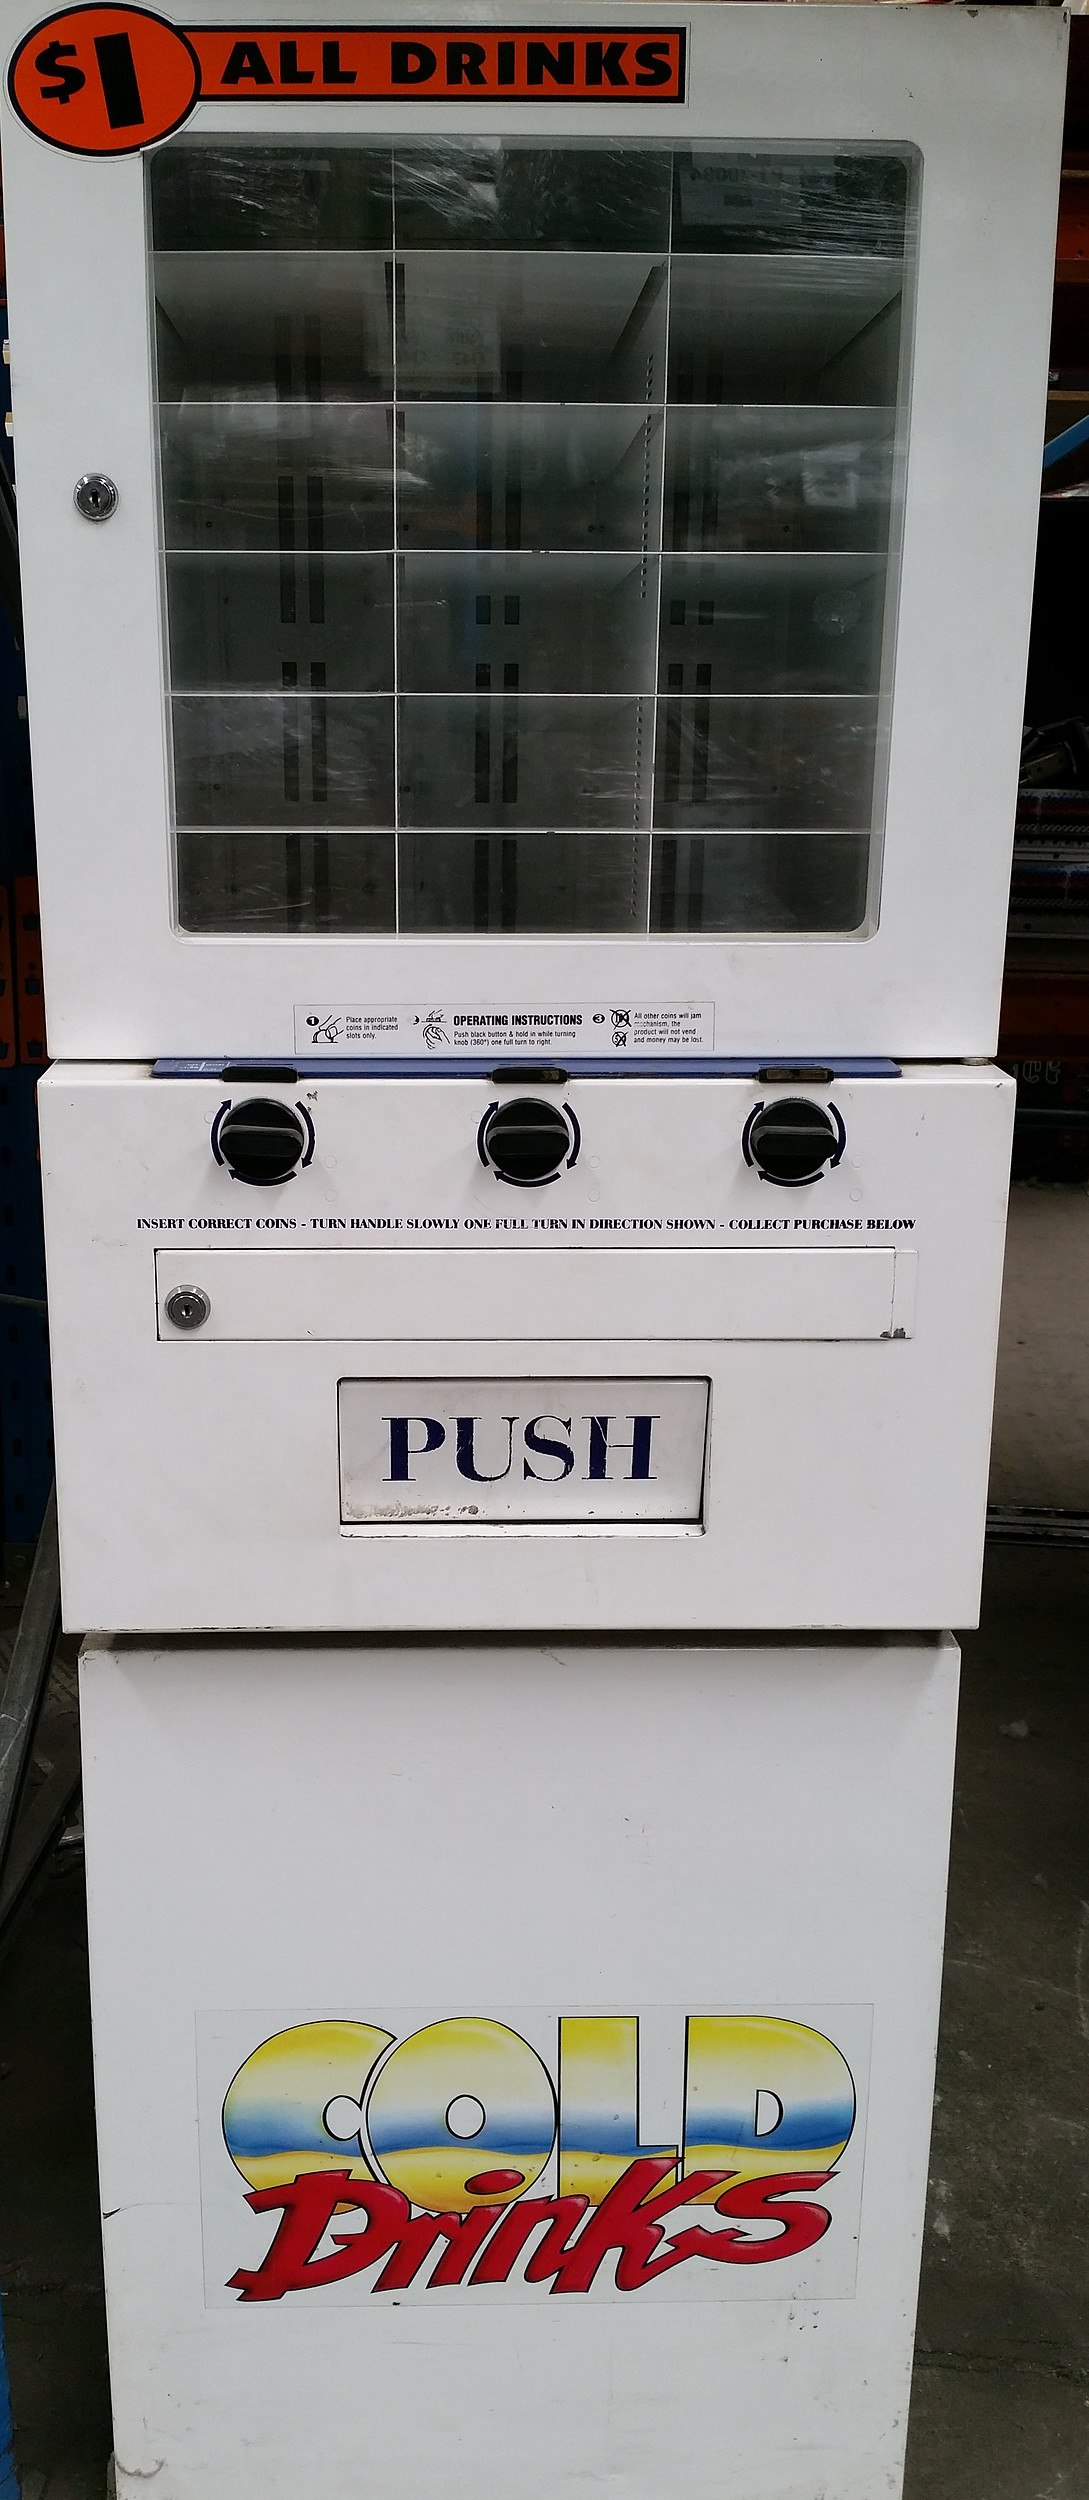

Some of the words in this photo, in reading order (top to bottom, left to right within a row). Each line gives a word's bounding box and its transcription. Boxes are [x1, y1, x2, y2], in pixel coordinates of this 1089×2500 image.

[220, 41, 358, 86] ALL
[390, 41, 672, 87] DRINKS
[35, 32, 144, 129] $1
[453, 1015, 508, 1026] OPERATING
[511, 1014, 583, 1026] INSTRUCTIONS
[690, 1012, 702, 1020] jam
[363, 1016, 398, 1026] appropriate
[671, 1020, 681, 1028] the
[363, 1023, 370, 1031] in
[371, 1023, 399, 1031] indicated
[362, 1032, 376, 1040] only.
[537, 1030, 553, 1038] while
[554, 1031, 576, 1039] turning
[633, 1028, 657, 1036] product
[503, 1038, 514, 1046] full
[646, 1037, 666, 1045] money
[667, 1036, 681, 1044] may
[137, 1218, 185, 1230] INSERT
[188, 1218, 253, 1230] CORRECT
[255, 1218, 297, 1230] COINS
[310, 1218, 347, 1230] TURN
[350, 1218, 404, 1230] HANDLE
[406, 1218, 460, 1230] SLOWLY
[463, 1218, 492, 1230] ONE
[495, 1218, 529, 1230] FULL
[531, 1218, 568, 1230] TURN
[571, 1218, 586, 1230] IN
[589, 1218, 663, 1230] DIRECTION
[666, 1218, 716, 1230] SHOWN
[728, 1218, 791, 1230] COLLECT
[793, 1218, 863, 1230] PURCHASE
[866, 1218, 917, 1230] BELOW
[381, 1415, 661, 1483] PUSH
[222, 2016, 856, 2214] COLD
